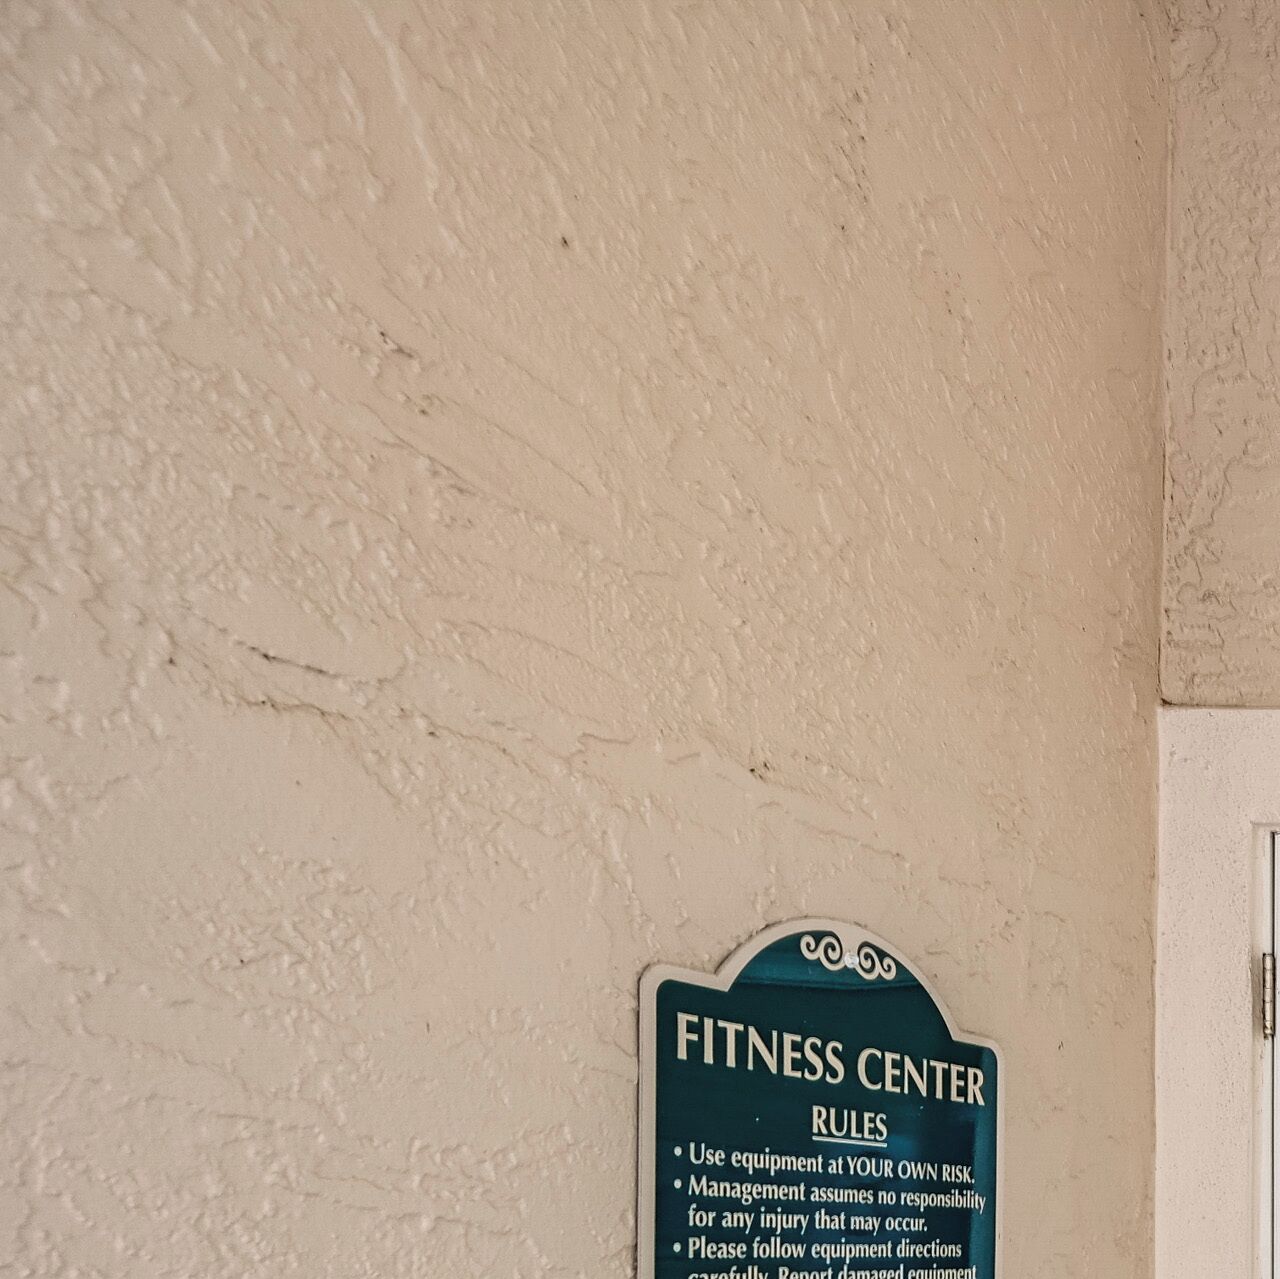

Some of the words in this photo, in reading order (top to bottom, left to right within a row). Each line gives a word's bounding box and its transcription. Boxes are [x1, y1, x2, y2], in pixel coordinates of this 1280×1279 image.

[676, 1011, 845, 1084] FITNESS
[857, 1048, 985, 1105] CENTER
[812, 1105, 888, 1147] RULES
[689, 1142, 725, 1166] Use
[731, 1148, 823, 1175] equipment
[828, 1159, 844, 1174] at
[846, 1156, 893, 1178] YOUR
[897, 1160, 938, 1182] OWN
[942, 1165, 975, 1184] RISK.
[688, 1174, 805, 1204] Management
[810, 1182, 874, 1205] assumes
[878, 1191, 896, 1205] no
[900, 1189, 986, 1214] responsibility
[687, 1204, 716, 1229] for
[722, 1210, 754, 1233] any
[760, 1207, 809, 1234] injury
[814, 1210, 846, 1230] that
[850, 1216, 881, 1236] may
[885, 1216, 927, 1232] occur.
[687, 1237, 747, 1259] Please
[752, 1237, 807, 1259] follow
[811, 1239, 892, 1264] equipment
[896, 1237, 962, 1258] directions
